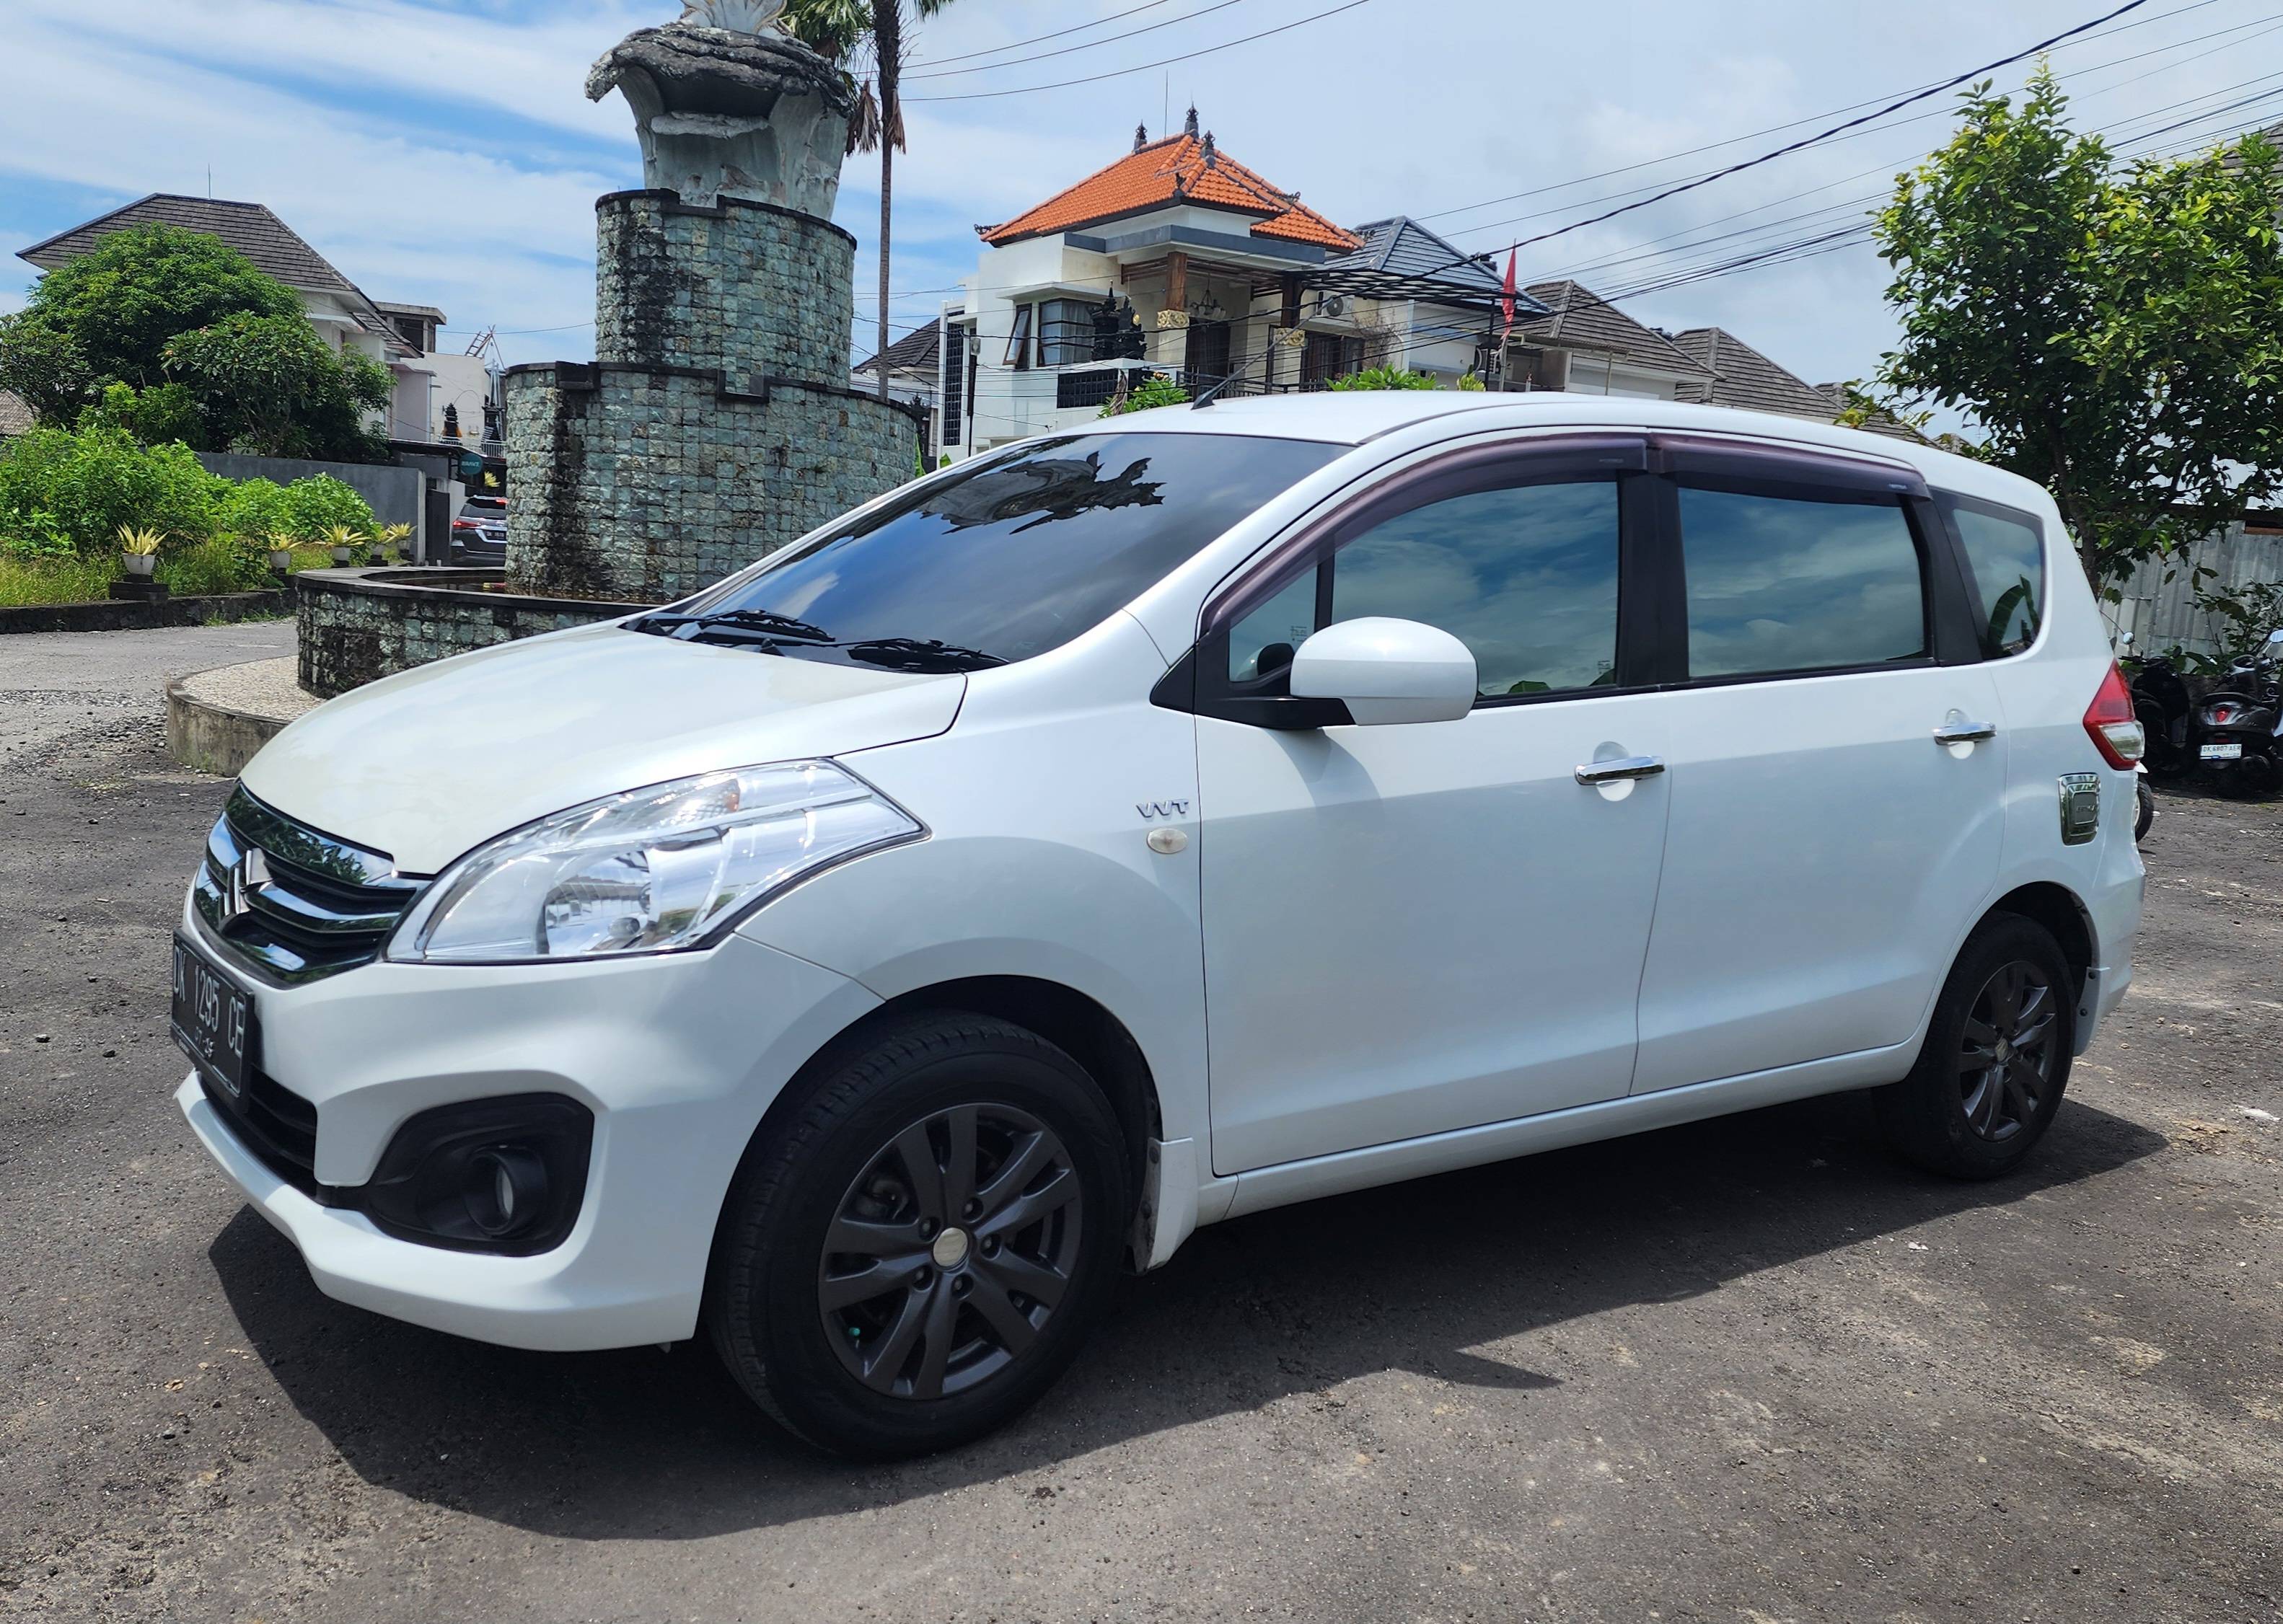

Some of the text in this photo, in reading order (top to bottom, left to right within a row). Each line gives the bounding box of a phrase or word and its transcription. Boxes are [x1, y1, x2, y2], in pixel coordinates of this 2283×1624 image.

[1135, 799, 1189, 818] VVT
[174, 945, 186, 1002] DK
[195, 965, 219, 1032] 1295
